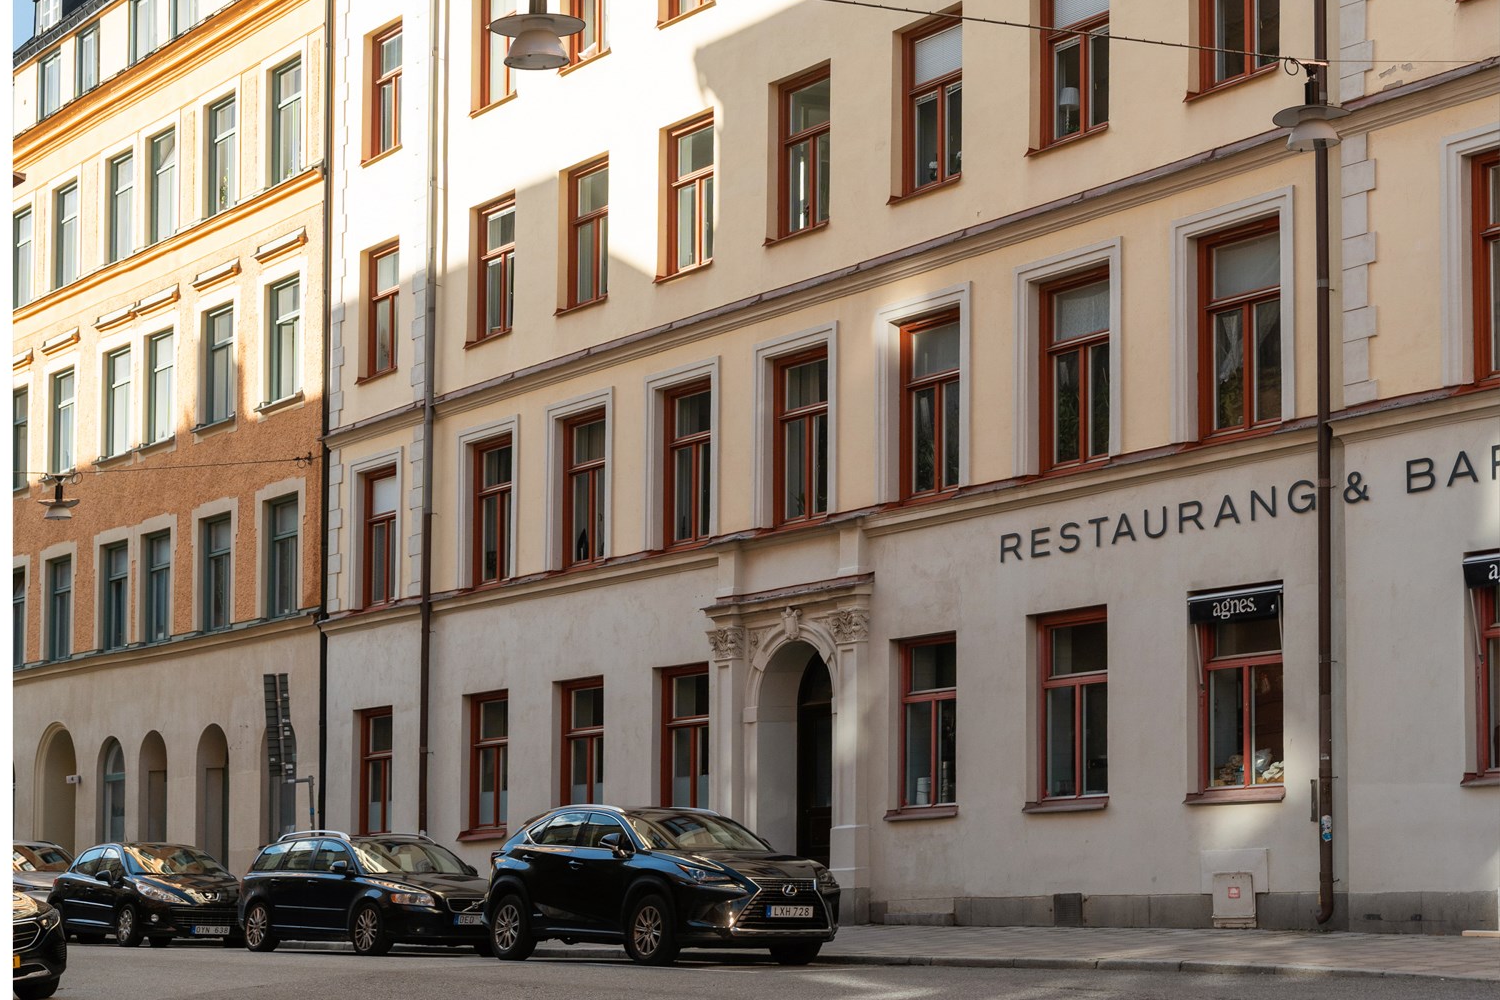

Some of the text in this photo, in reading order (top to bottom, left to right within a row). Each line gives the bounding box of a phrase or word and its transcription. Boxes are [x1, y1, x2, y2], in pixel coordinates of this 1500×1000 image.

[999, 479, 1317, 563] RESTAURANG
[1343, 471, 1369, 504] &
[1212, 597, 1257, 619] agnes.
[774, 907, 810, 916] LXH 728
